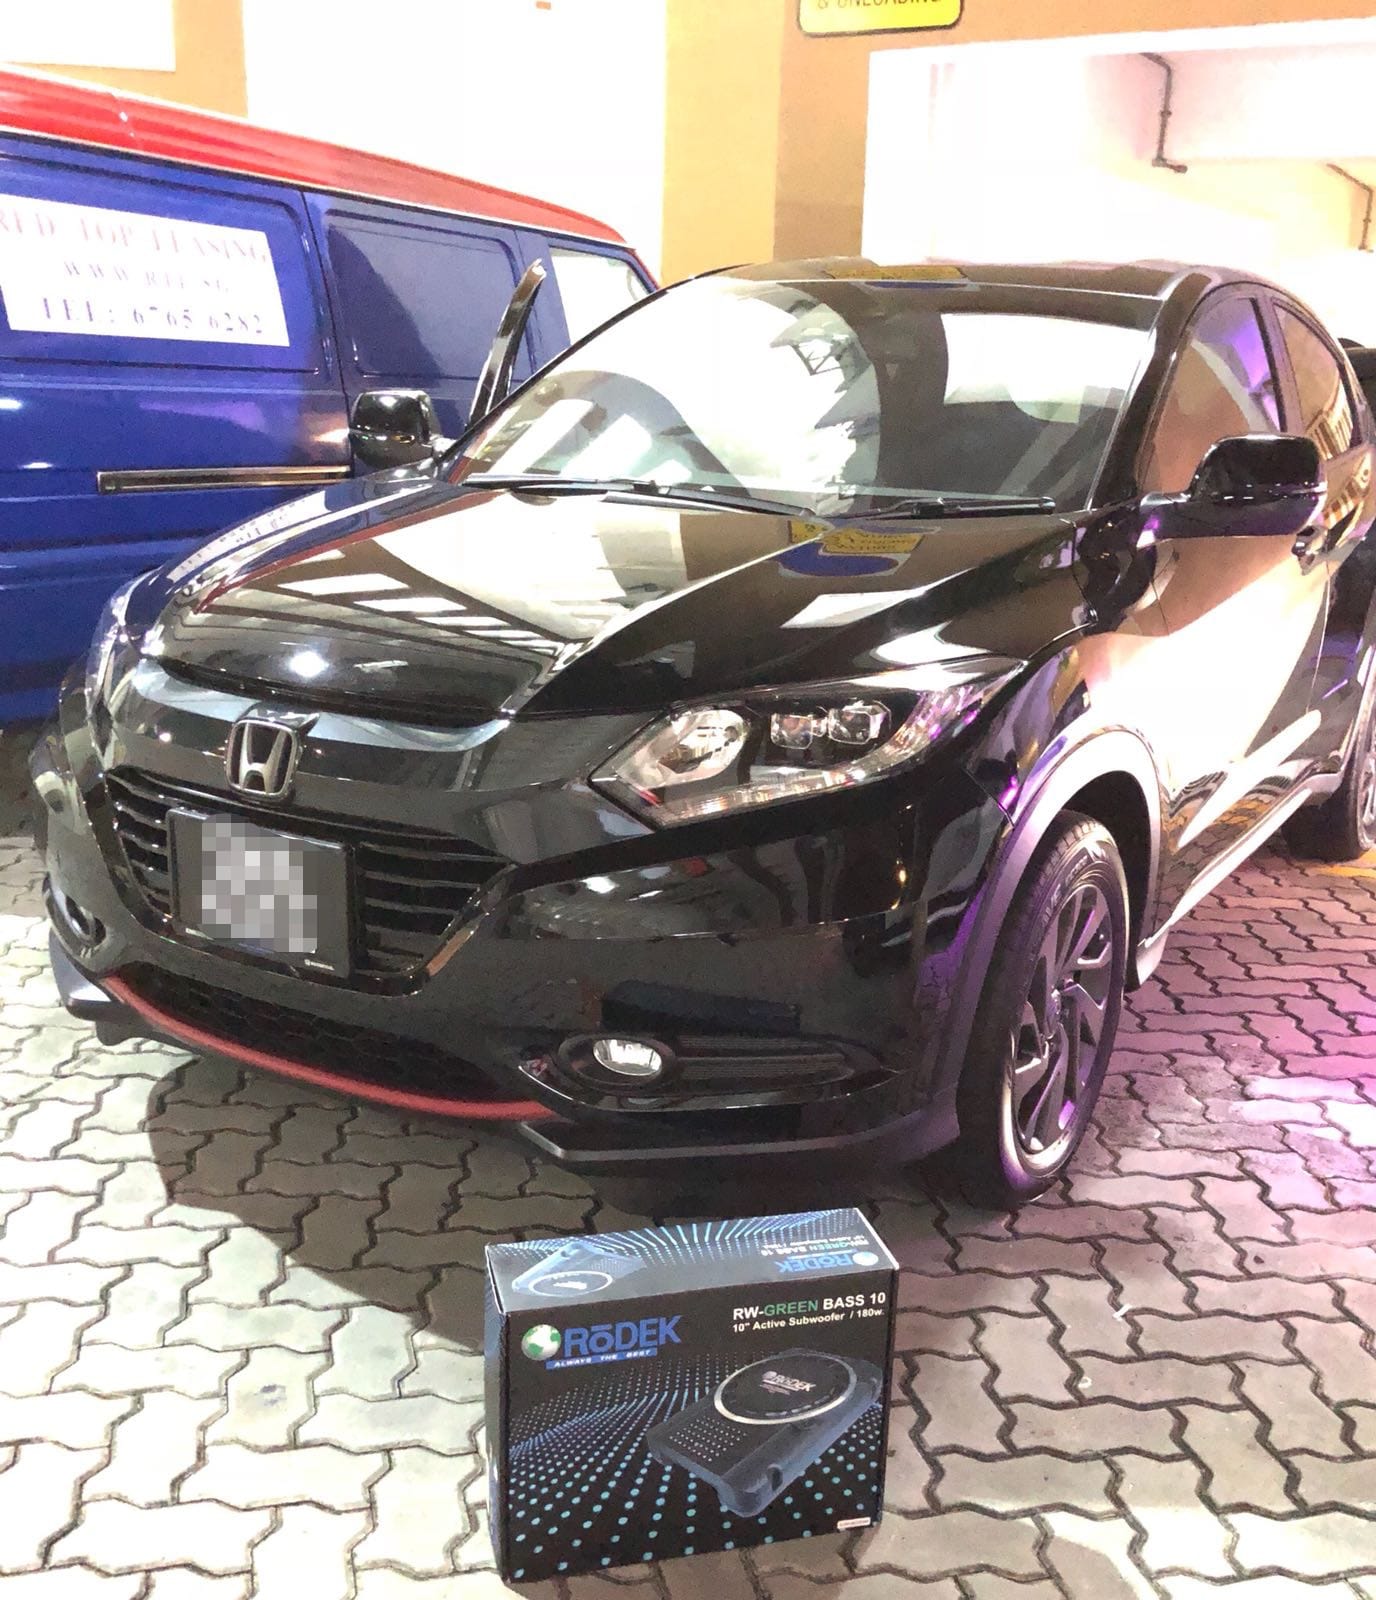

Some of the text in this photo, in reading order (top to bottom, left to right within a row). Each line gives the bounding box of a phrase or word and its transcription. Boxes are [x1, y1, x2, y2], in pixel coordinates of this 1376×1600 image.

[837, 0, 942, 9] UNLOA
[207, 310, 263, 335] 6282
[732, 1292, 886, 1321] RW-GREEN BASS 10
[732, 1322, 750, 1333] 10"
[752, 1317, 786, 1331] Active
[788, 1312, 845, 1327] Subwoofer
[553, 1357, 592, 1368] ALWAYS
[625, 1350, 651, 1359] BEST
